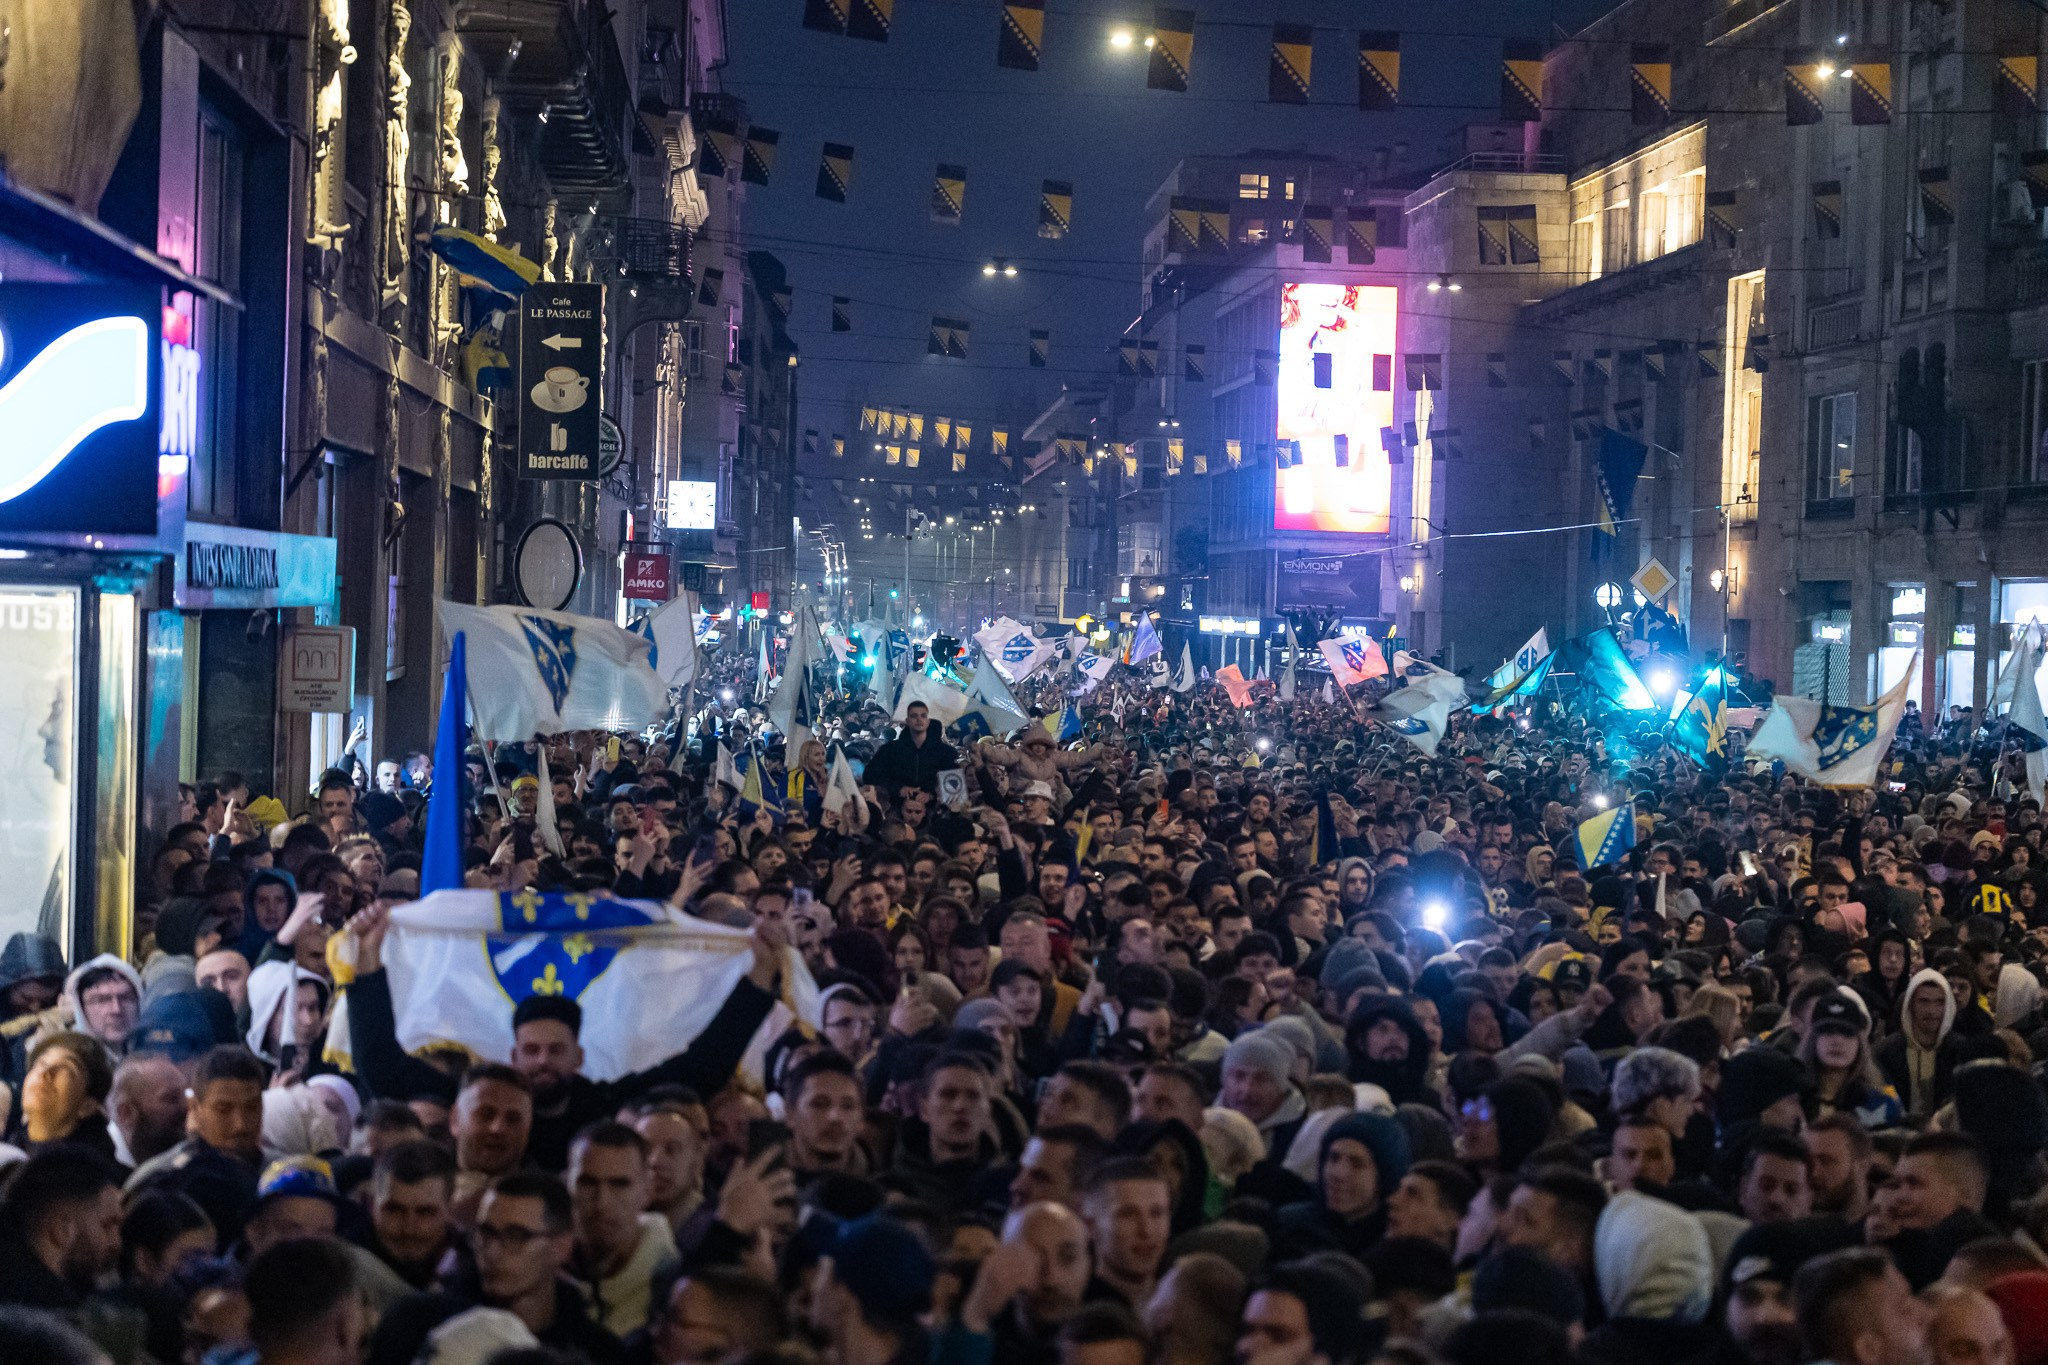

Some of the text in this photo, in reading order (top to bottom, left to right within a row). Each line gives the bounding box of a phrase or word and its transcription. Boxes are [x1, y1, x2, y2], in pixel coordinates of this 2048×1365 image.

[552, 298, 572, 306] Cafe
[530, 308, 592, 319] LE PASSAGE
[528, 453, 589, 470] barcaffé
[1284, 560, 1330, 571] ENMON
[627, 578, 665, 589] AMKO
